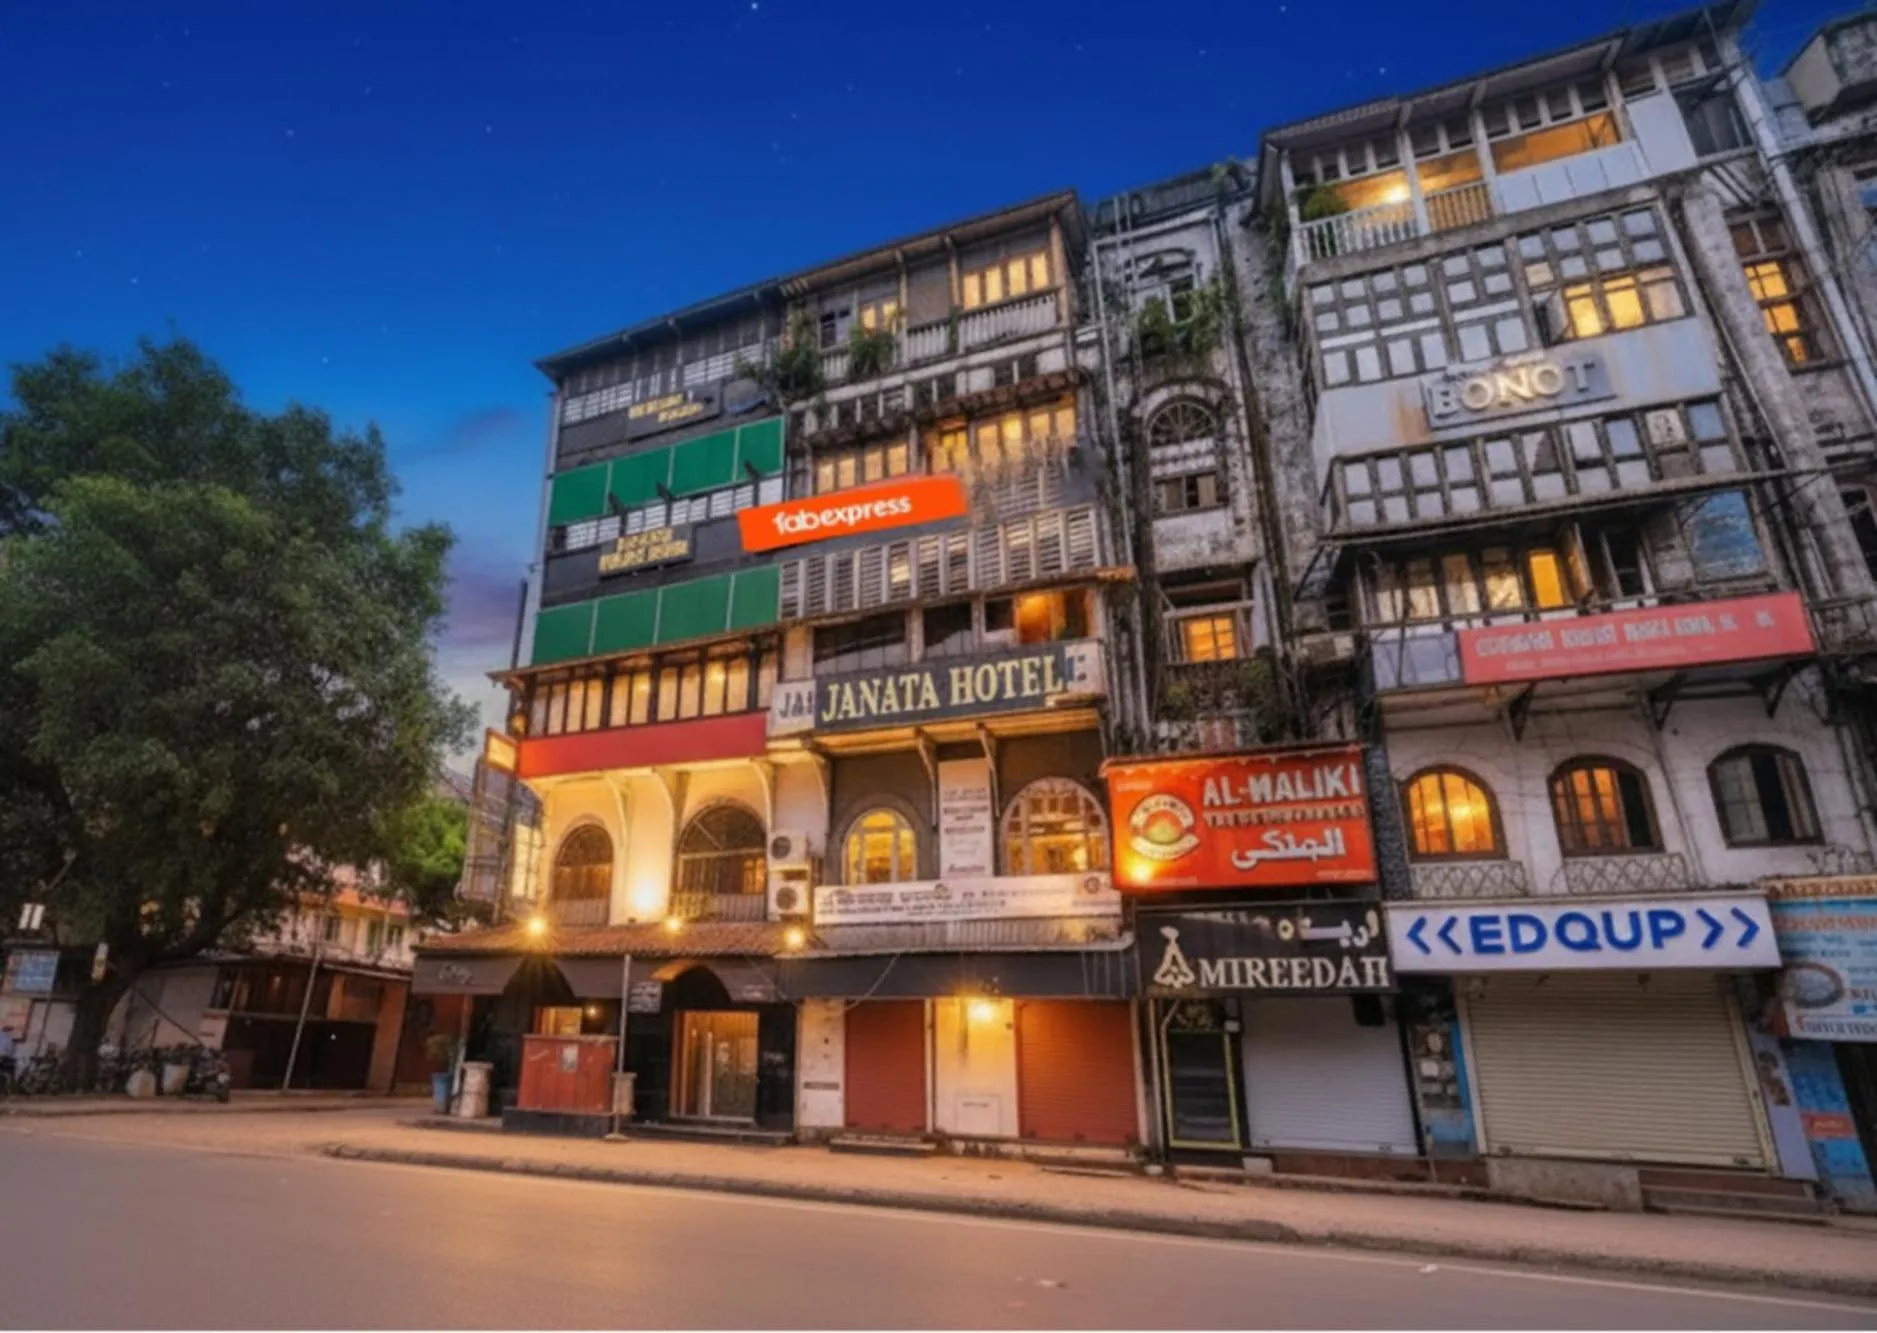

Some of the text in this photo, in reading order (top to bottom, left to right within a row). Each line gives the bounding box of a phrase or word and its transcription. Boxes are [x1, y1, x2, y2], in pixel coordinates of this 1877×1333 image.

[772, 496, 913, 535] fabexpress
[821, 672, 940, 722] JANATA
[949, 655, 1064, 706] HOTEL
[1468, 908, 1686, 955] EDQUP
